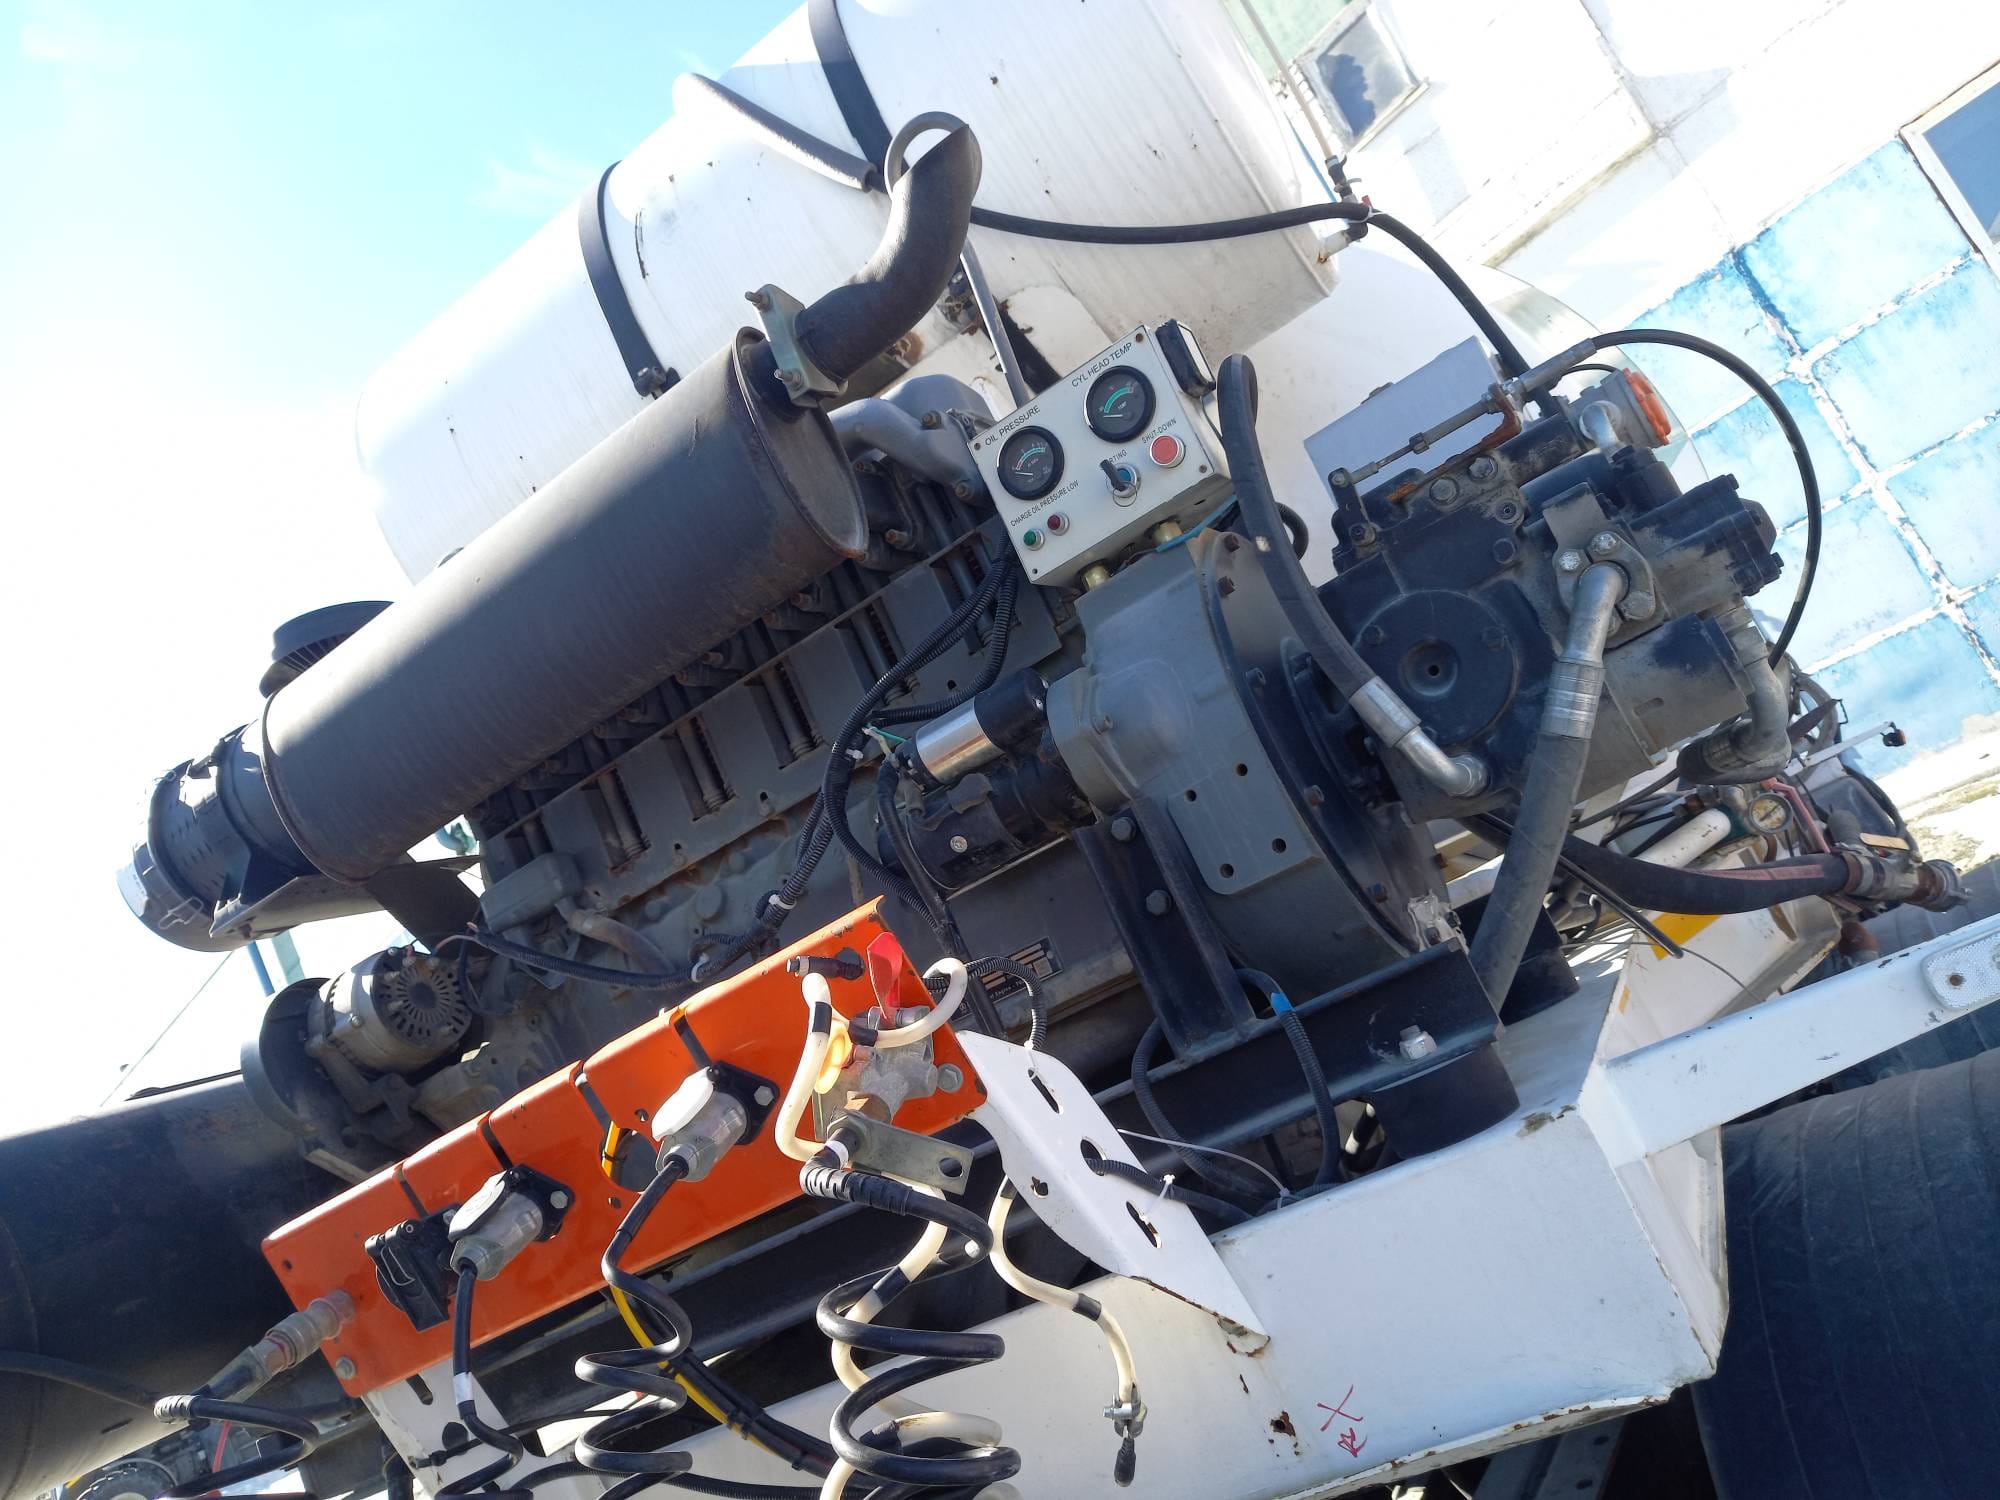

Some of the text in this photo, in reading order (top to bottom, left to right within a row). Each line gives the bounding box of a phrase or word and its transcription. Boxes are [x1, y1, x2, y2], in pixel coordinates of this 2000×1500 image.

[1071, 342, 1132, 387] CYL HEAD TEMP
[985, 405, 1040, 446] OIL PRESSURE
[1141, 417, 1177, 444] SHUT-DOWN
[1010, 479, 1080, 527] CHARGE OIL PRESSURE LOW
